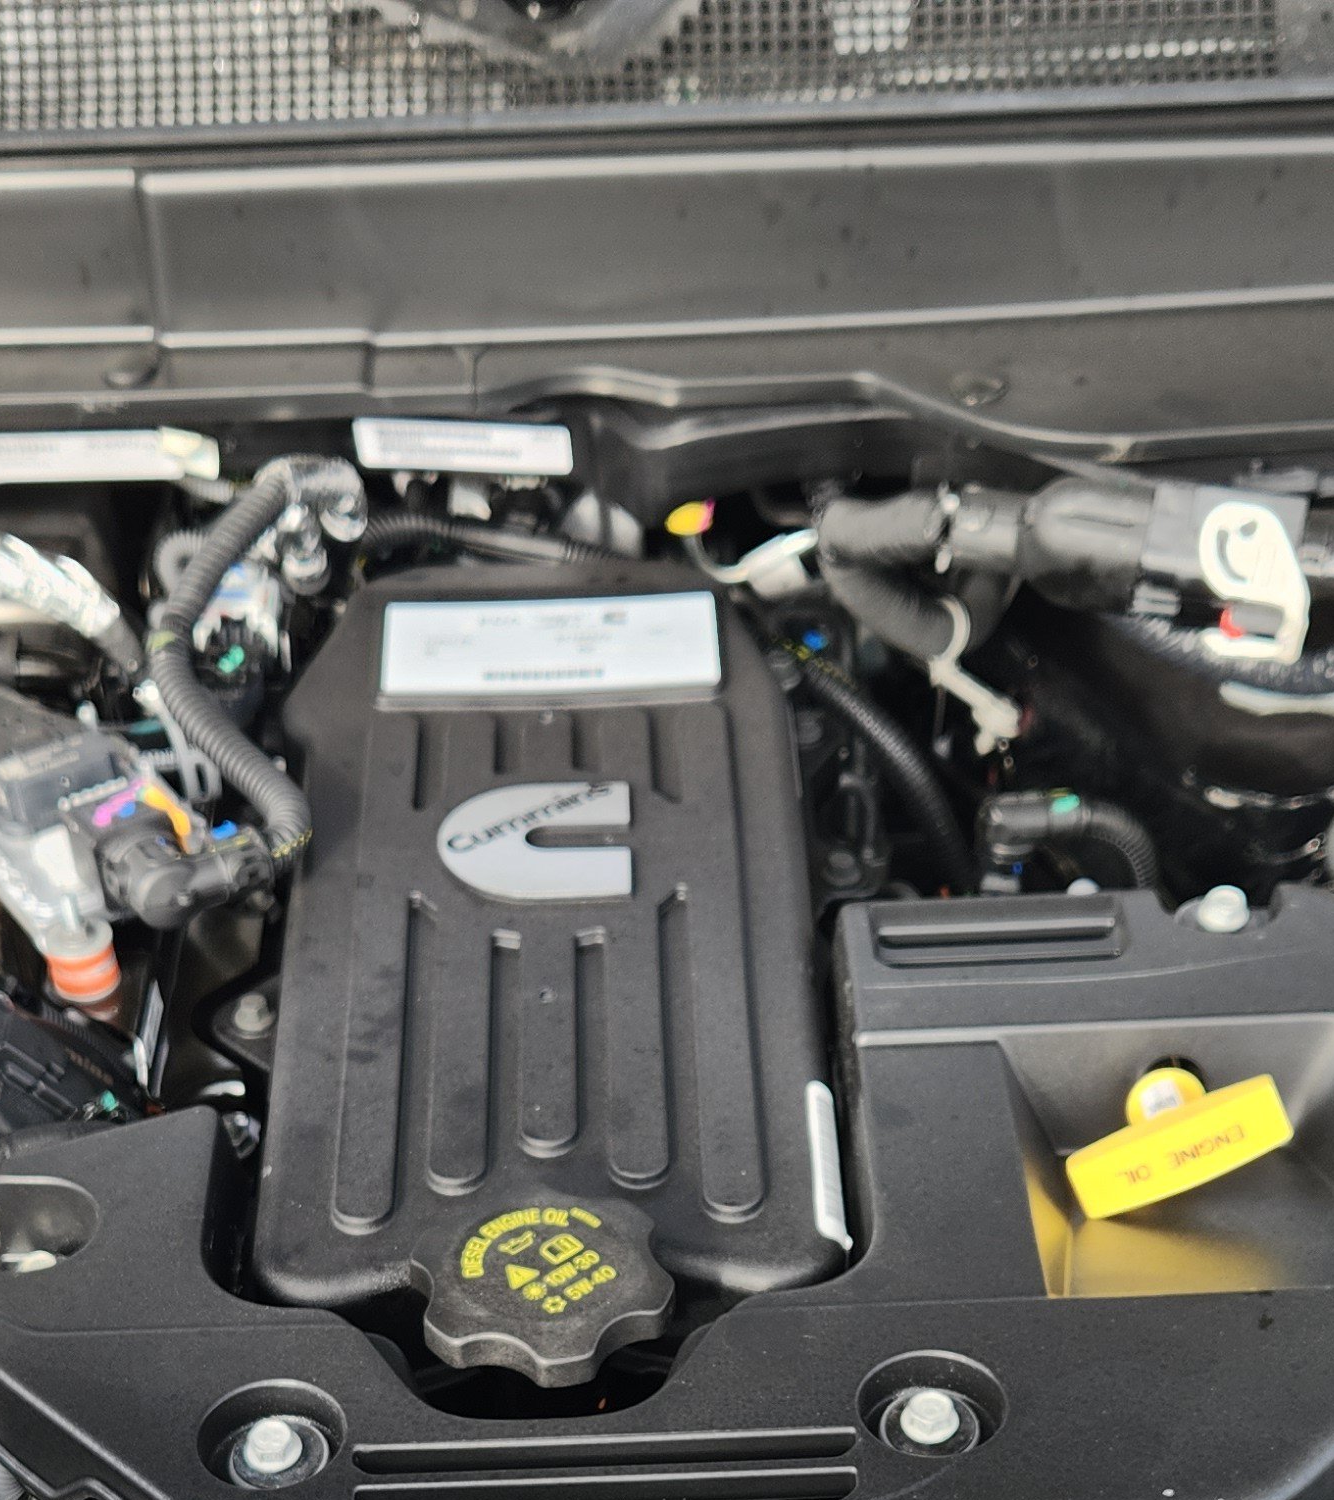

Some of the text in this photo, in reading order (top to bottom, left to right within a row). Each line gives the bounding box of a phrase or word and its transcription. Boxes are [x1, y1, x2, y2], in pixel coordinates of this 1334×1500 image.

[446, 783, 611, 853] Cummins
[1116, 1124, 1246, 1185] ENGINE OIL
[461, 1236, 492, 1279] DIESEL
[479, 1207, 540, 1240] ENGINE
[542, 1207, 569, 1227] OIL
[543, 1249, 600, 1288] 10W-30
[564, 1265, 617, 1301] 5W-40
